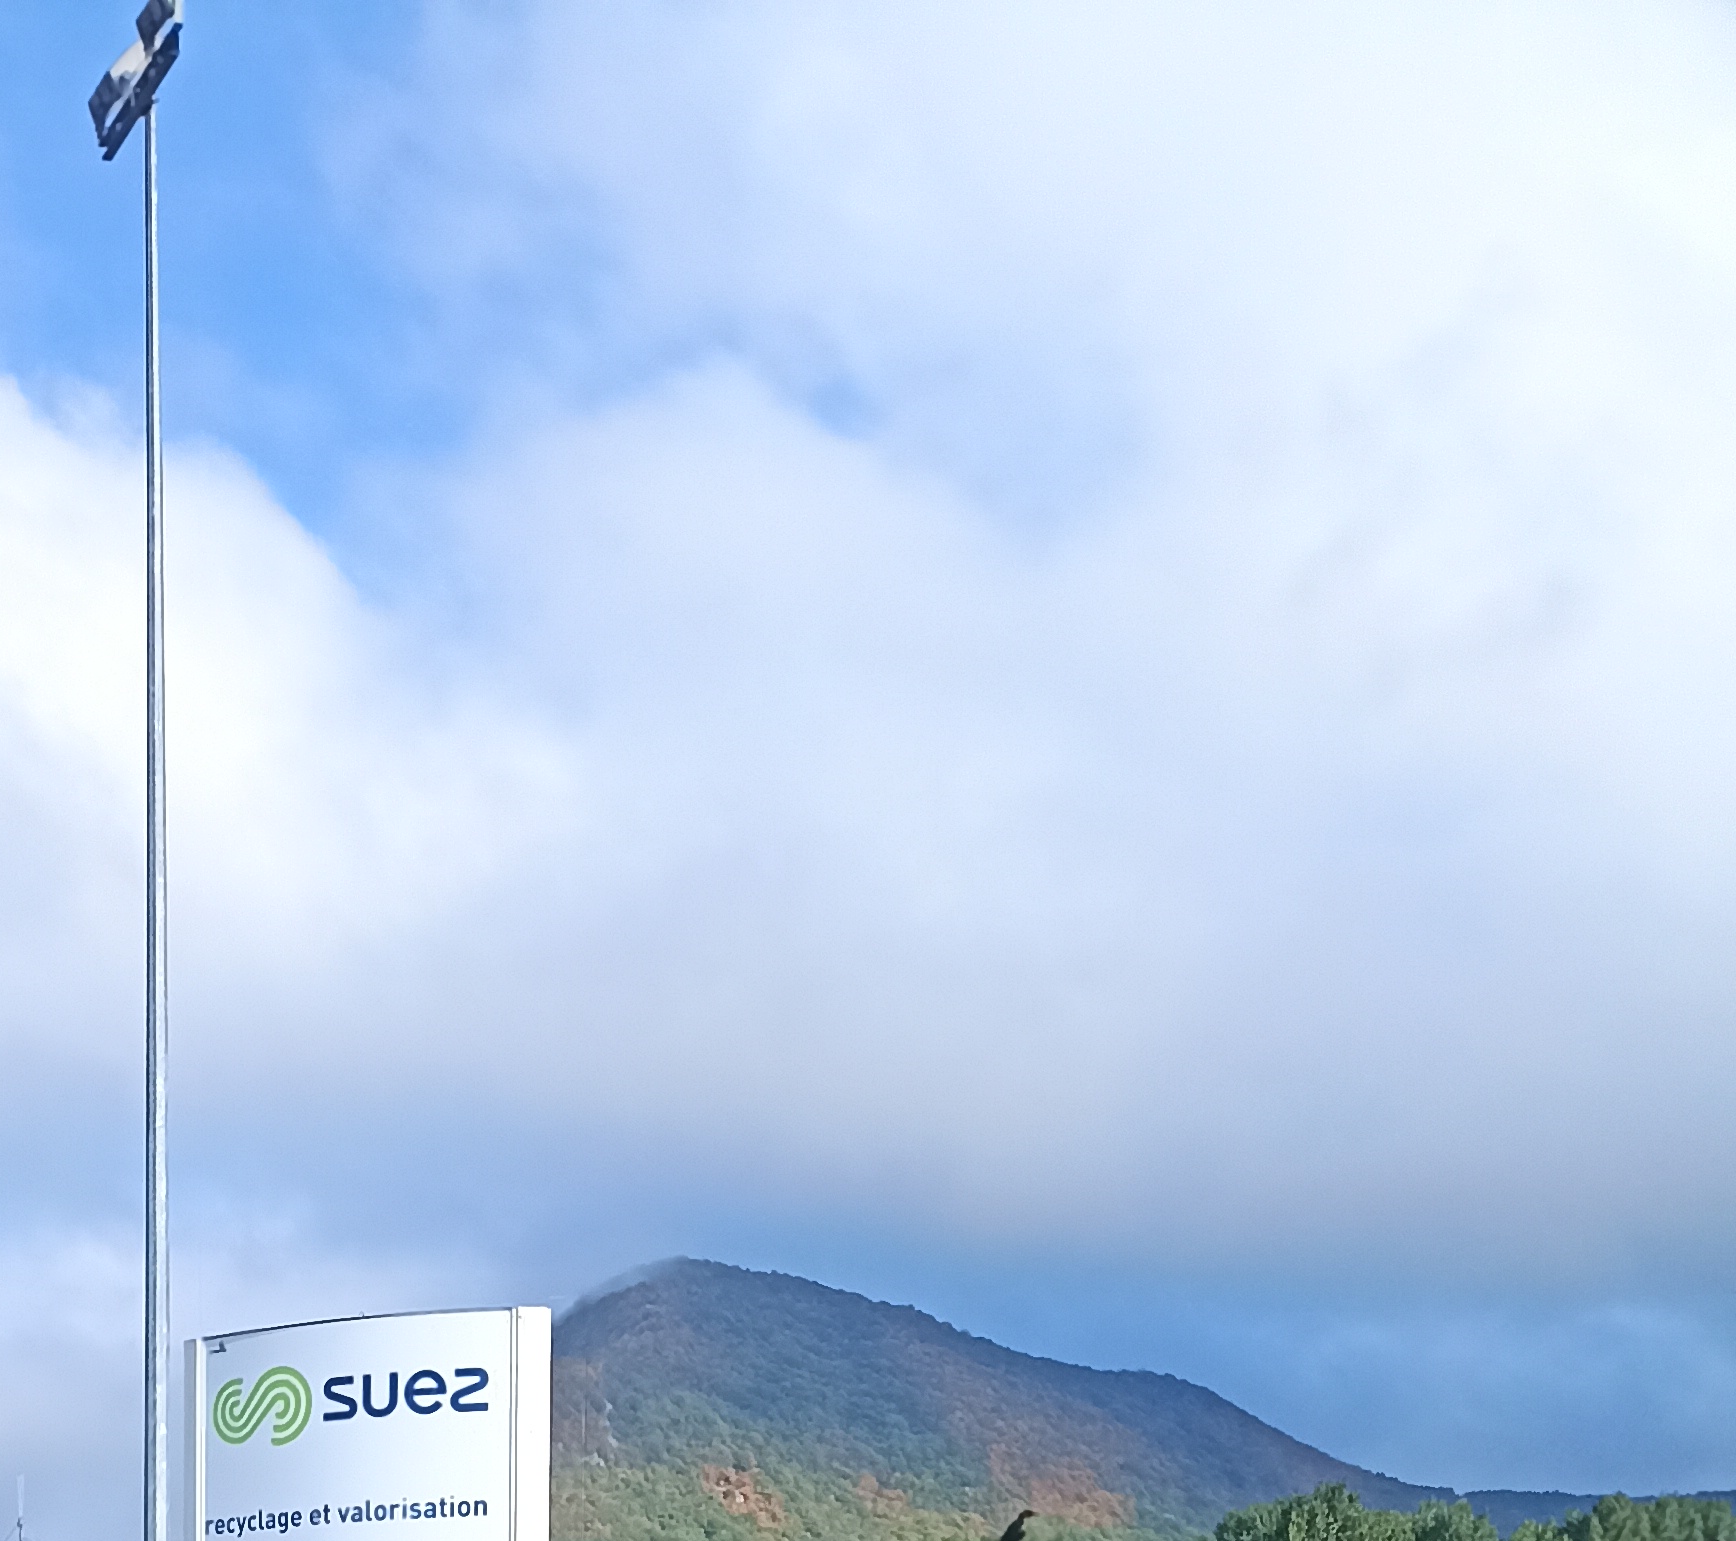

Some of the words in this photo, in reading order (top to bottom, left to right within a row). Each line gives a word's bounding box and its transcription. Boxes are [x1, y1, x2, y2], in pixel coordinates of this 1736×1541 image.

[322, 1366, 490, 1422] suez
[204, 1508, 303, 1538] recyclage
[309, 1502, 331, 1526] et
[337, 1494, 489, 1524] valorisation
